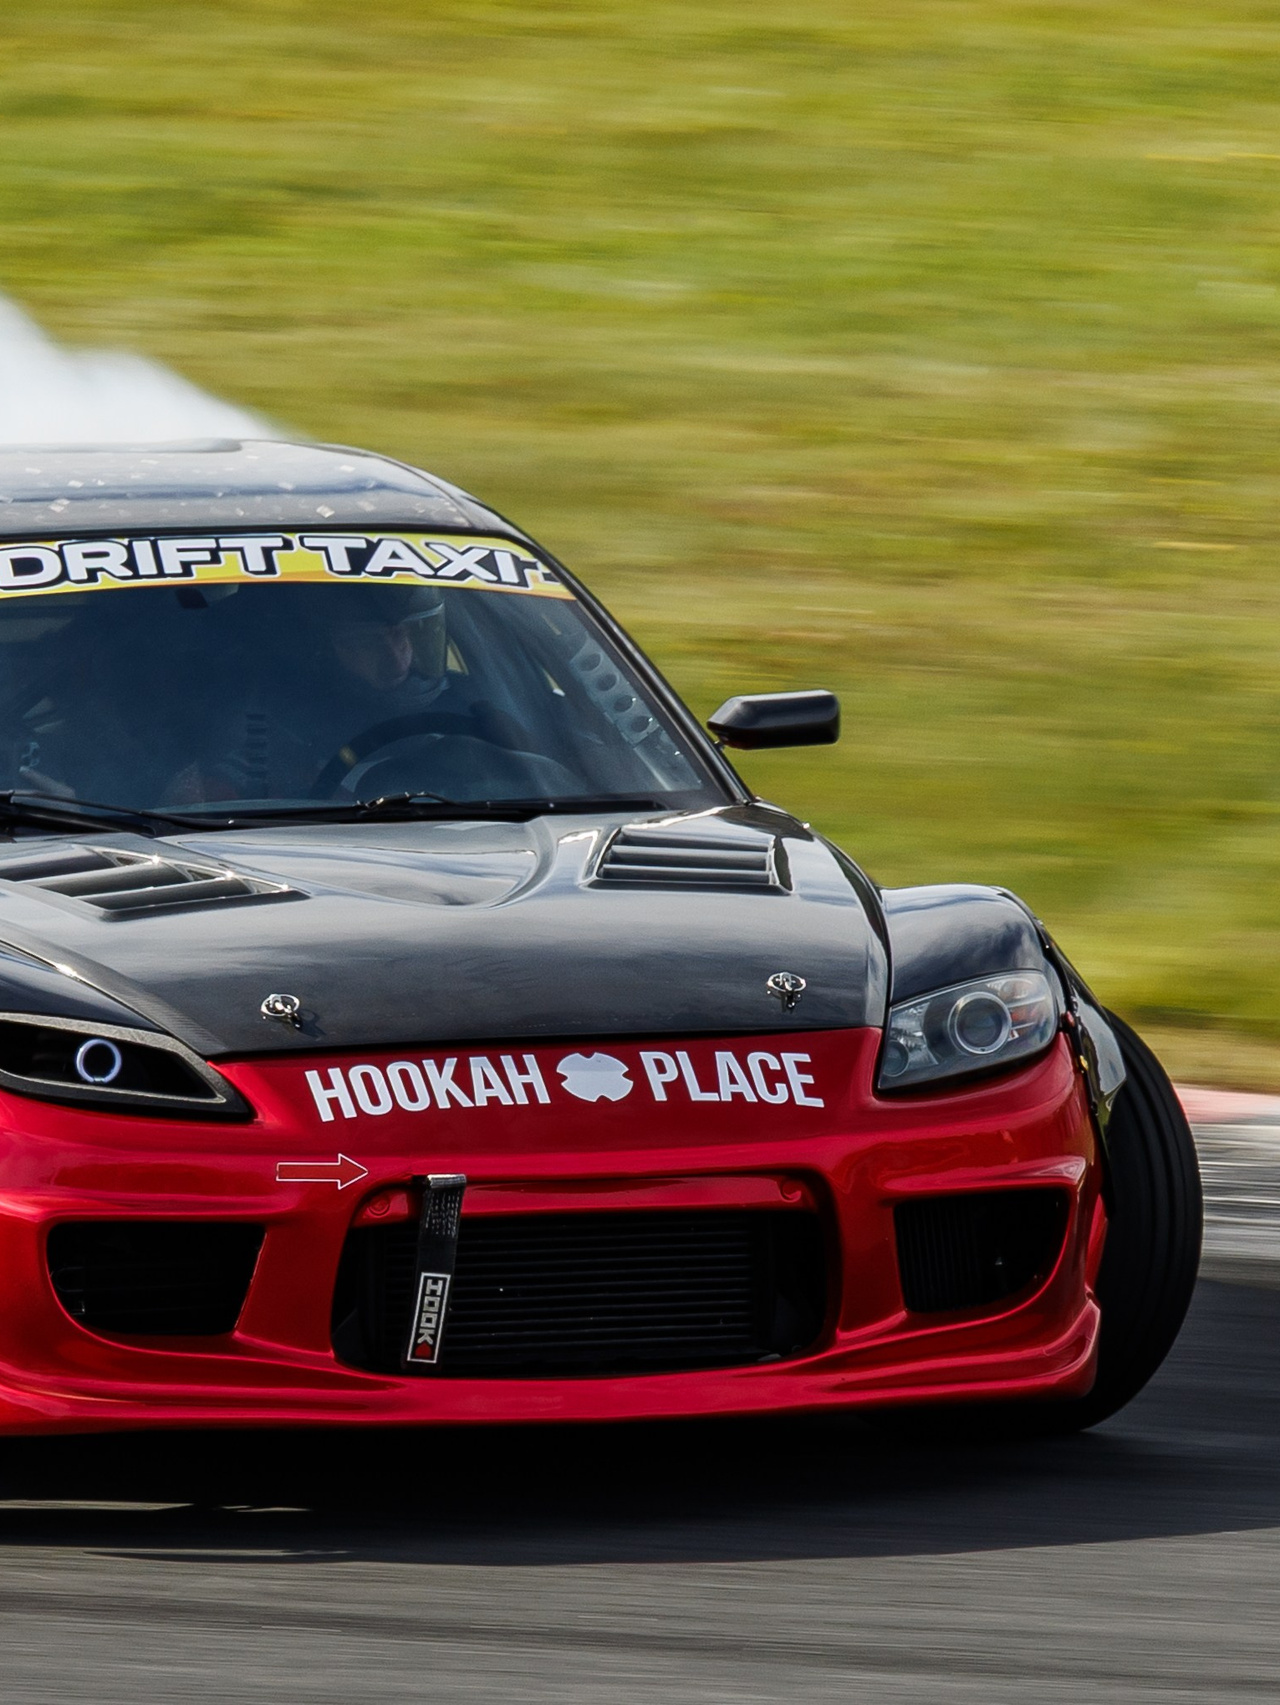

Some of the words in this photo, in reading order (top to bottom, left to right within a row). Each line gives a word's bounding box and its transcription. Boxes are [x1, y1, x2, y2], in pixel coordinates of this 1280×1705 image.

[300, 536, 526, 586] TAXI
[304, 1054, 552, 1122] HOOKAH
[638, 1051, 825, 1108] PLACE
[417, 1279, 443, 1345] HOOK
